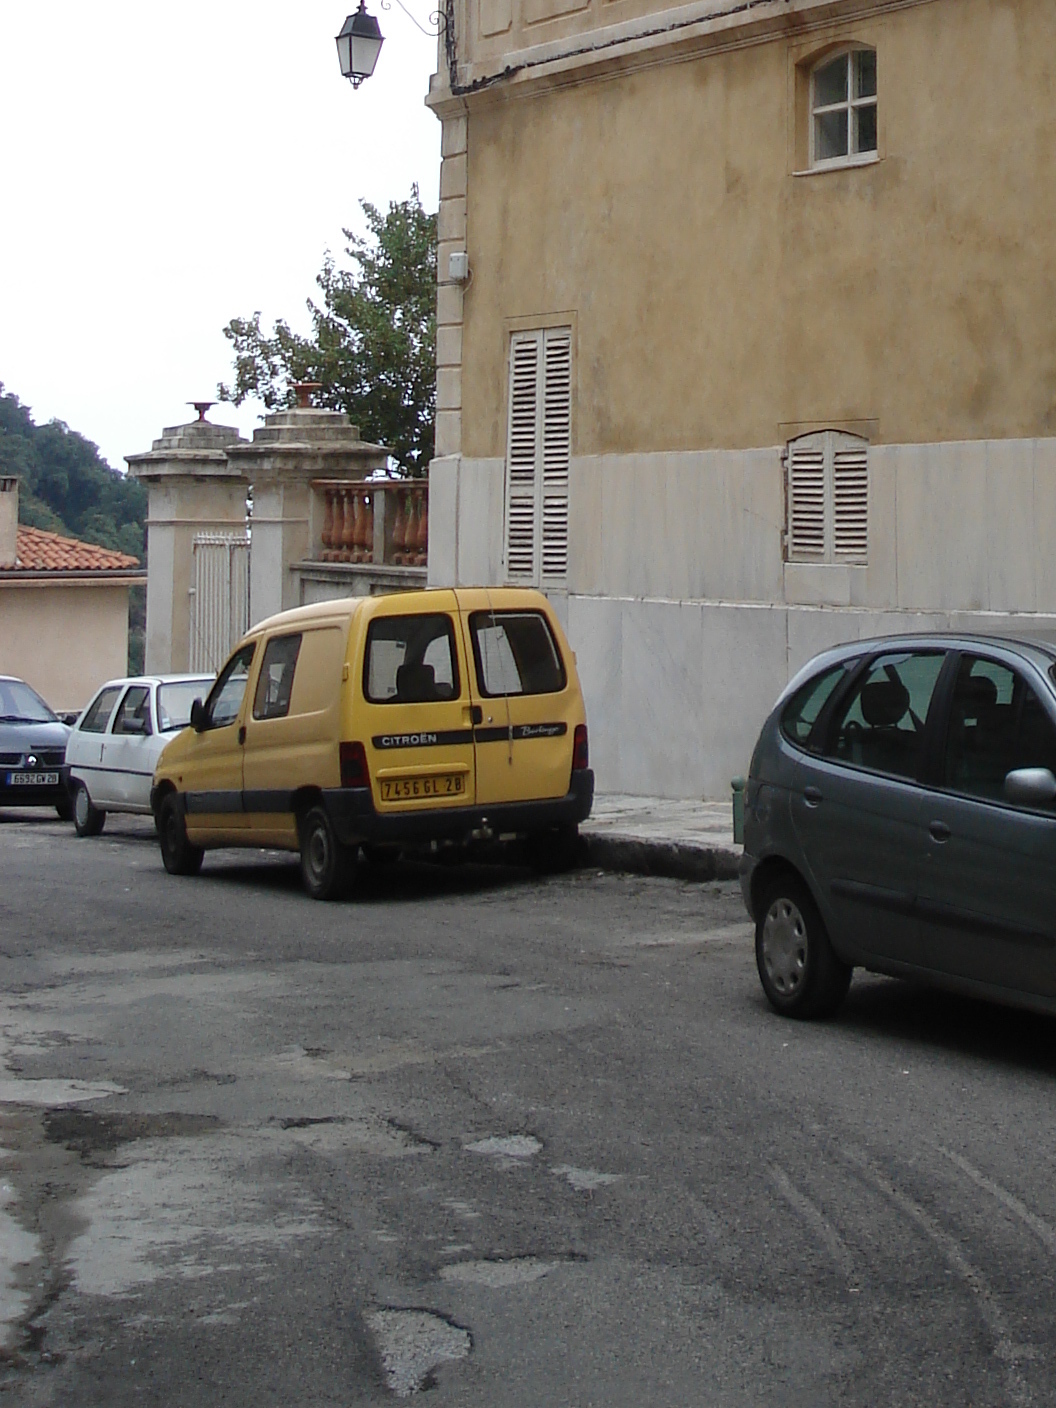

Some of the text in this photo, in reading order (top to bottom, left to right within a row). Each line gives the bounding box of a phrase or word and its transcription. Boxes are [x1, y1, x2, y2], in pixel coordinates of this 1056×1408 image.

[382, 733, 437, 746] CITROËN
[384, 780, 419, 798] 7456
[423, 779, 439, 795] GL
